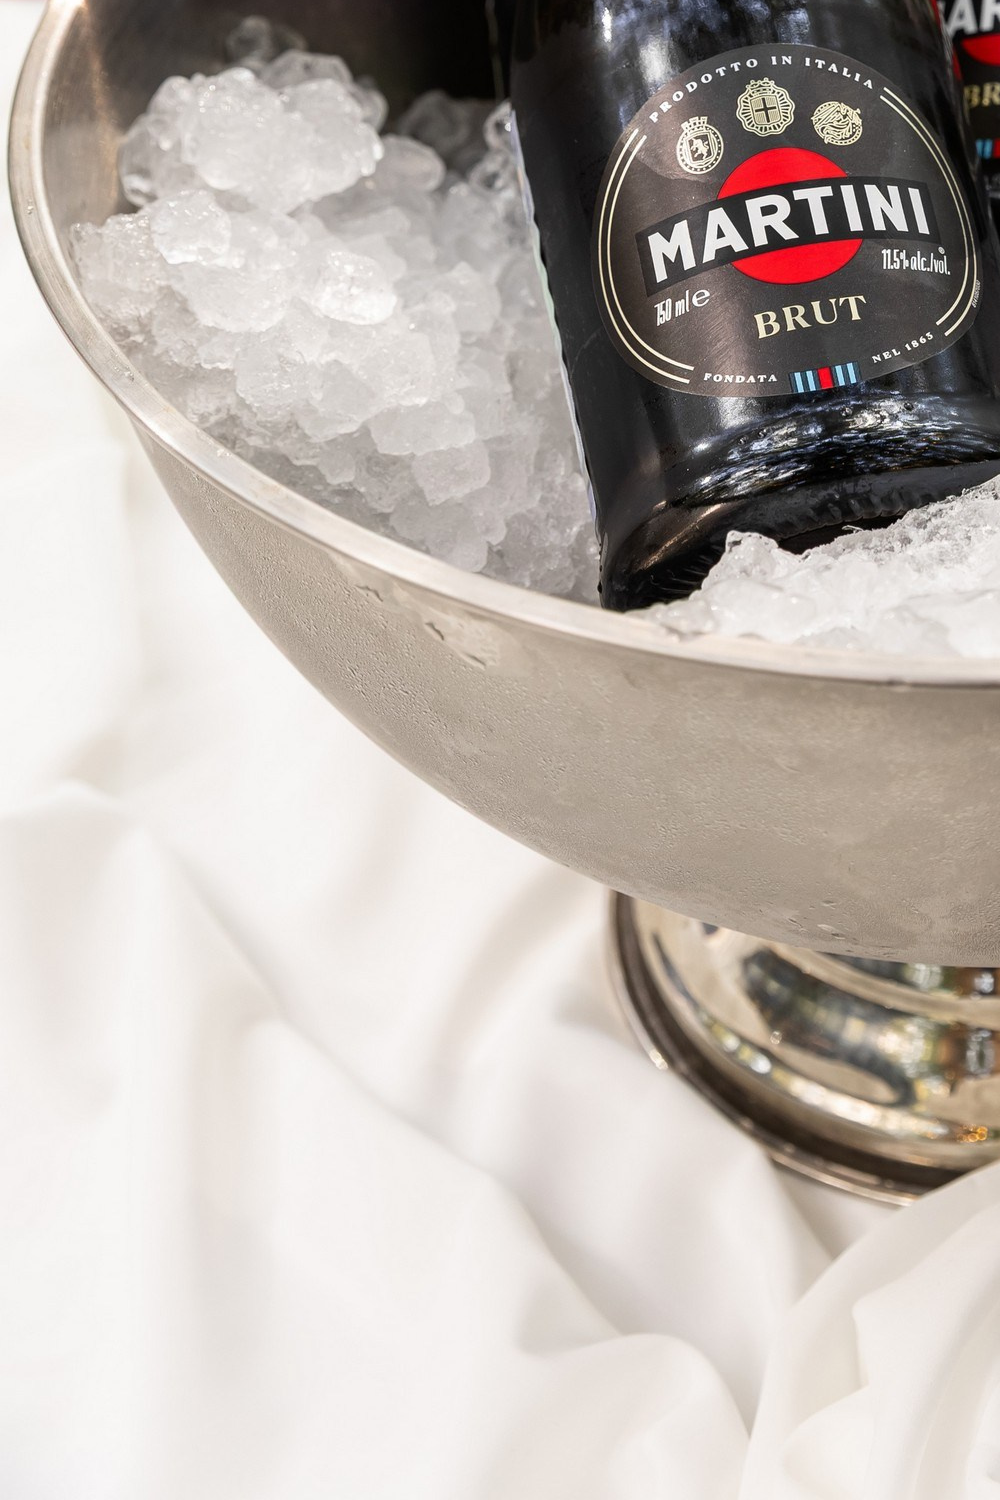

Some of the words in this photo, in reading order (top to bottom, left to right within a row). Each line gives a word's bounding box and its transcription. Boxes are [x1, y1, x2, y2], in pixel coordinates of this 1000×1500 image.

[649, 58, 758, 124] PRODOTTO
[771, 55, 793, 66] IN
[804, 57, 874, 90] ITALIA
[647, 184, 931, 284] MARTINI
[654, 298, 672, 327] 750
[675, 289, 690, 318] ml
[753, 295, 867, 339] BRUT
[871, 348, 901, 364] NEL
[904, 331, 934, 351] 1863
[703, 372, 778, 384] FONDATA
